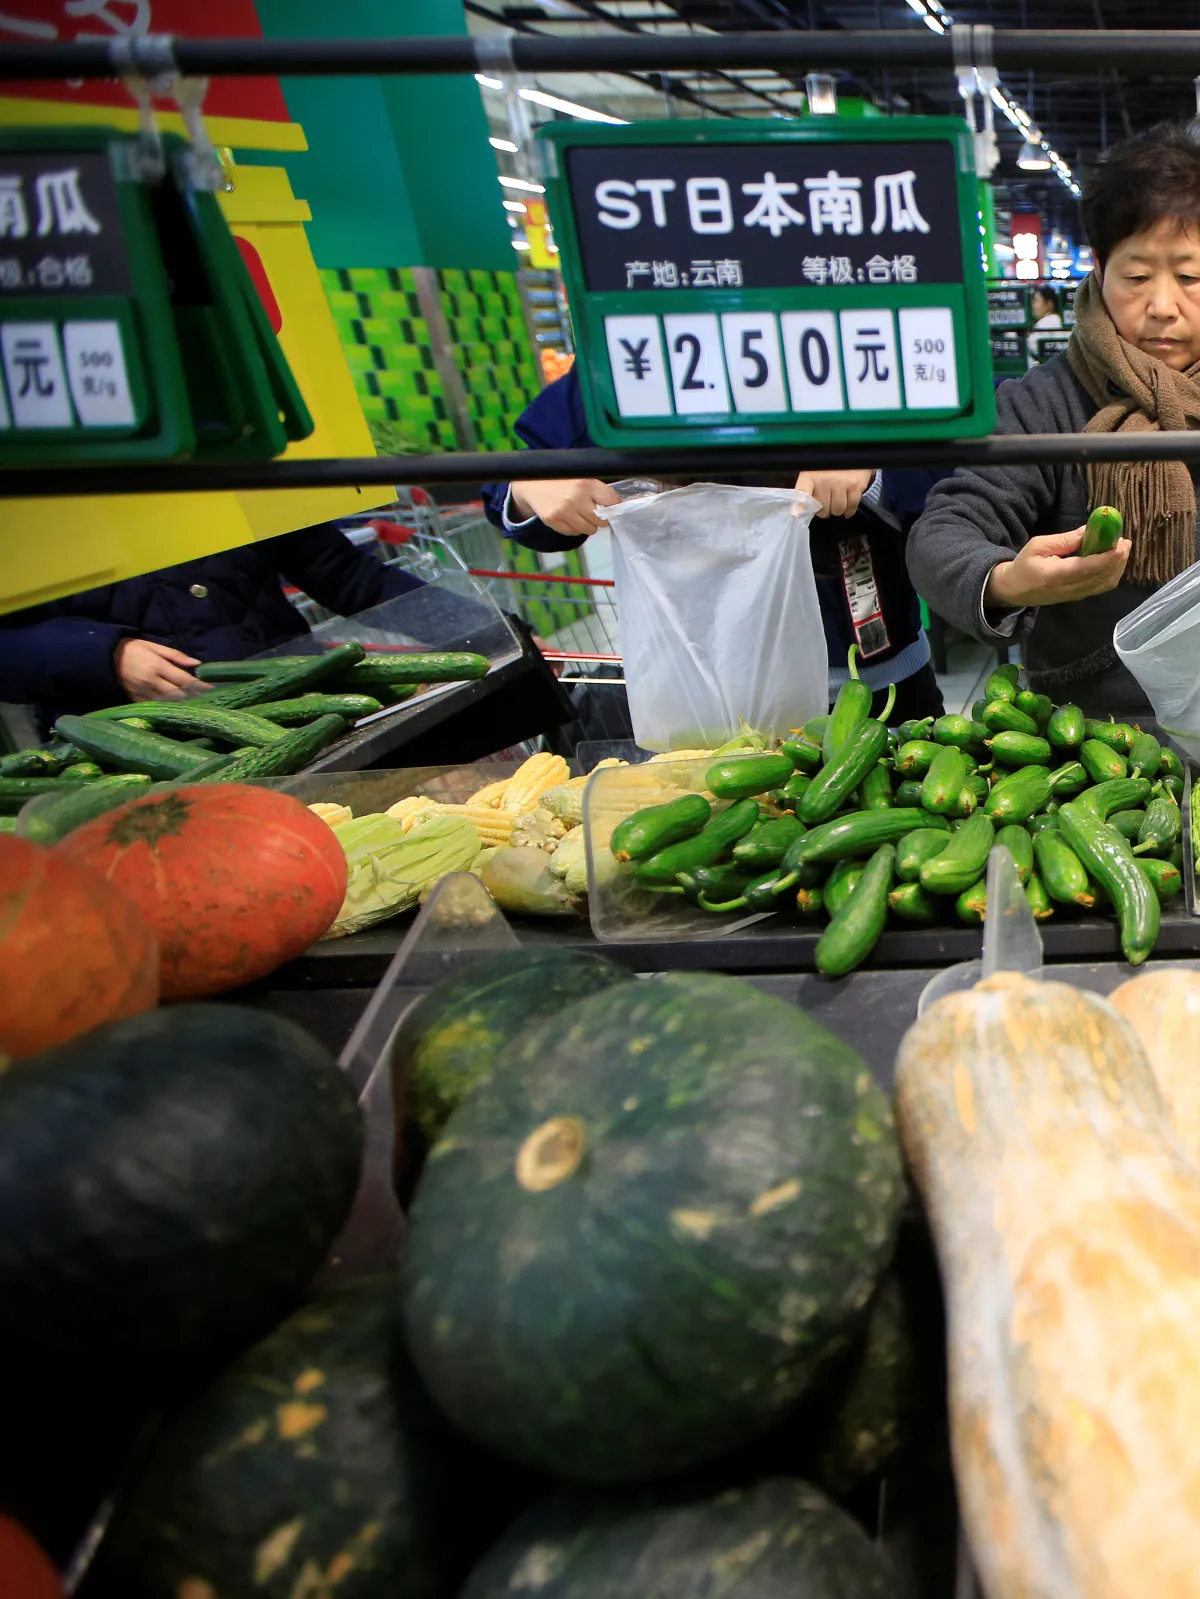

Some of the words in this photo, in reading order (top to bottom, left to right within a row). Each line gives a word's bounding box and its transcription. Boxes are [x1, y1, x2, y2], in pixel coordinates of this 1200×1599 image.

[595, 170, 931, 237] ST日本南瓜
[625, 258, 743, 288] 产地:云南
[801, 255, 917, 286] 等级:合格
[913, 338, 945, 354] 500
[13, 340, 54, 397] 元
[80, 352, 113, 367] 500
[914, 363, 946, 382] 克/g
